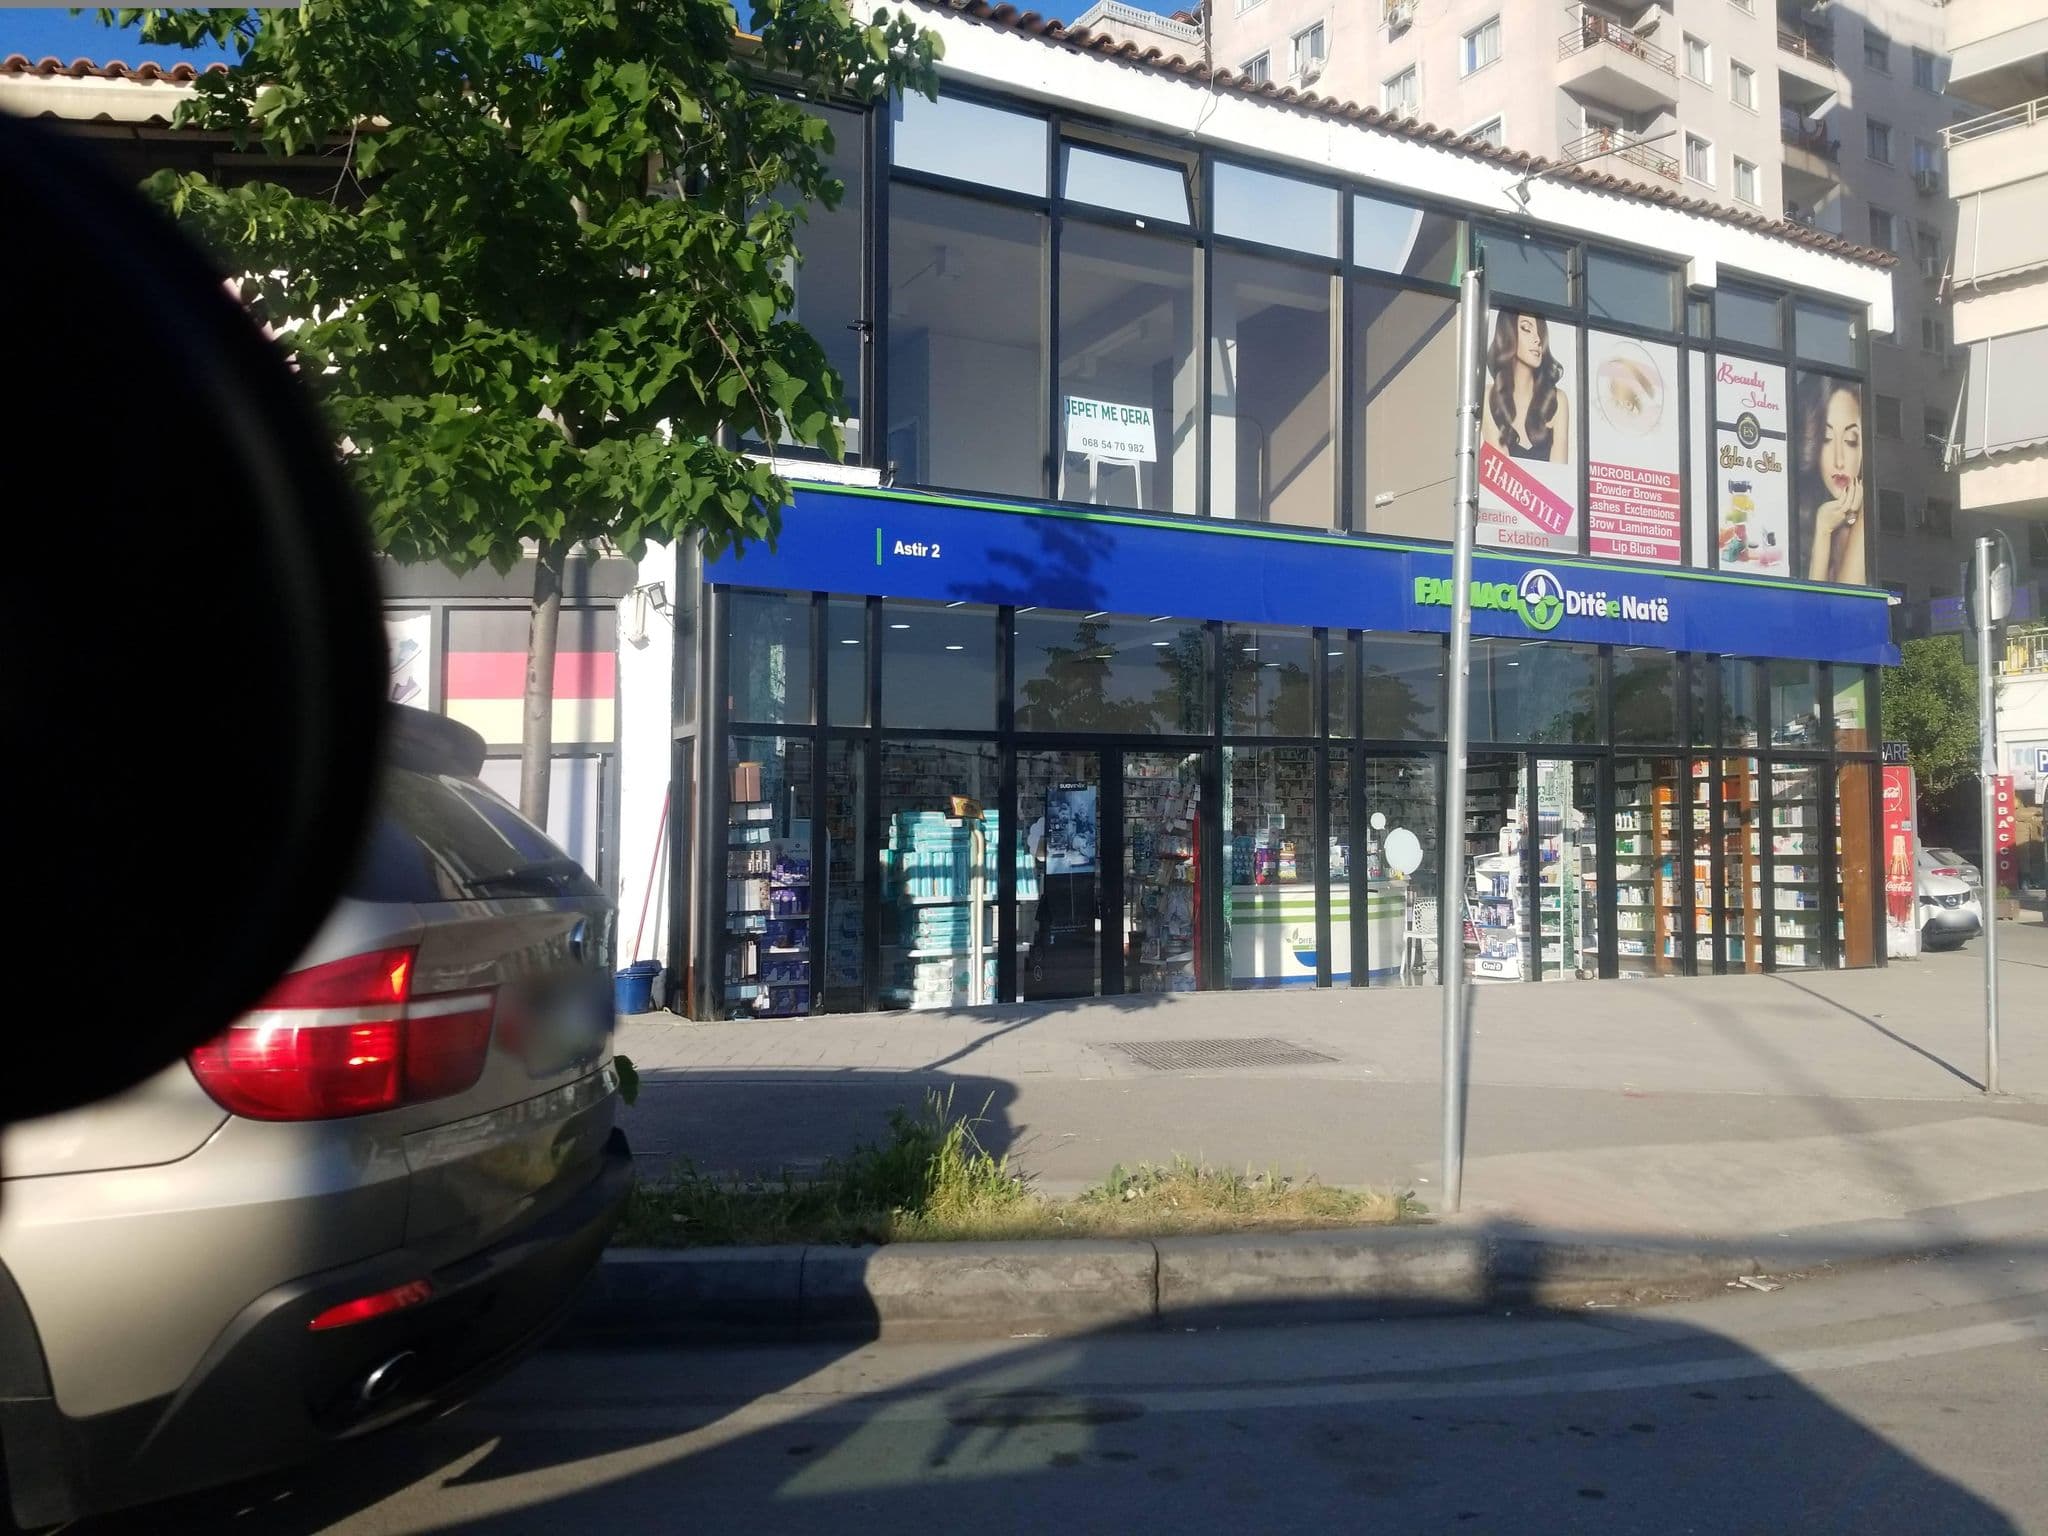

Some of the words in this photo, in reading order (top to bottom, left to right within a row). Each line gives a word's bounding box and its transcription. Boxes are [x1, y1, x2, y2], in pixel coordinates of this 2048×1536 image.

[1718, 362, 1765, 392] Beauty
[1066, 399, 1098, 418] JEPET
[1101, 405, 1118, 421] ME
[1742, 391, 1779, 410] Salon
[1082, 437, 1099, 448] 068
[1101, 439, 1112, 450] 54
[1114, 441, 1126, 452] 70
[1590, 465, 1671, 486] MICROBLADING
[1484, 454, 1564, 533] HAIRSTYLE
[1596, 482, 1631, 498] Powder
[1633, 488, 1663, 502] Brows
[1590, 516, 1614, 529] Brow
[1620, 520, 1673, 537] Lamination
[1498, 529, 1549, 547] Extation
[1612, 540, 1627, 555] Lip
[1630, 542, 1657, 556] Blush
[894, 540, 928, 557] Astir
[931, 543, 940, 558] 2
[1622, 595, 1669, 622] Natë
[1997, 778, 2010, 870] TOBACCO
